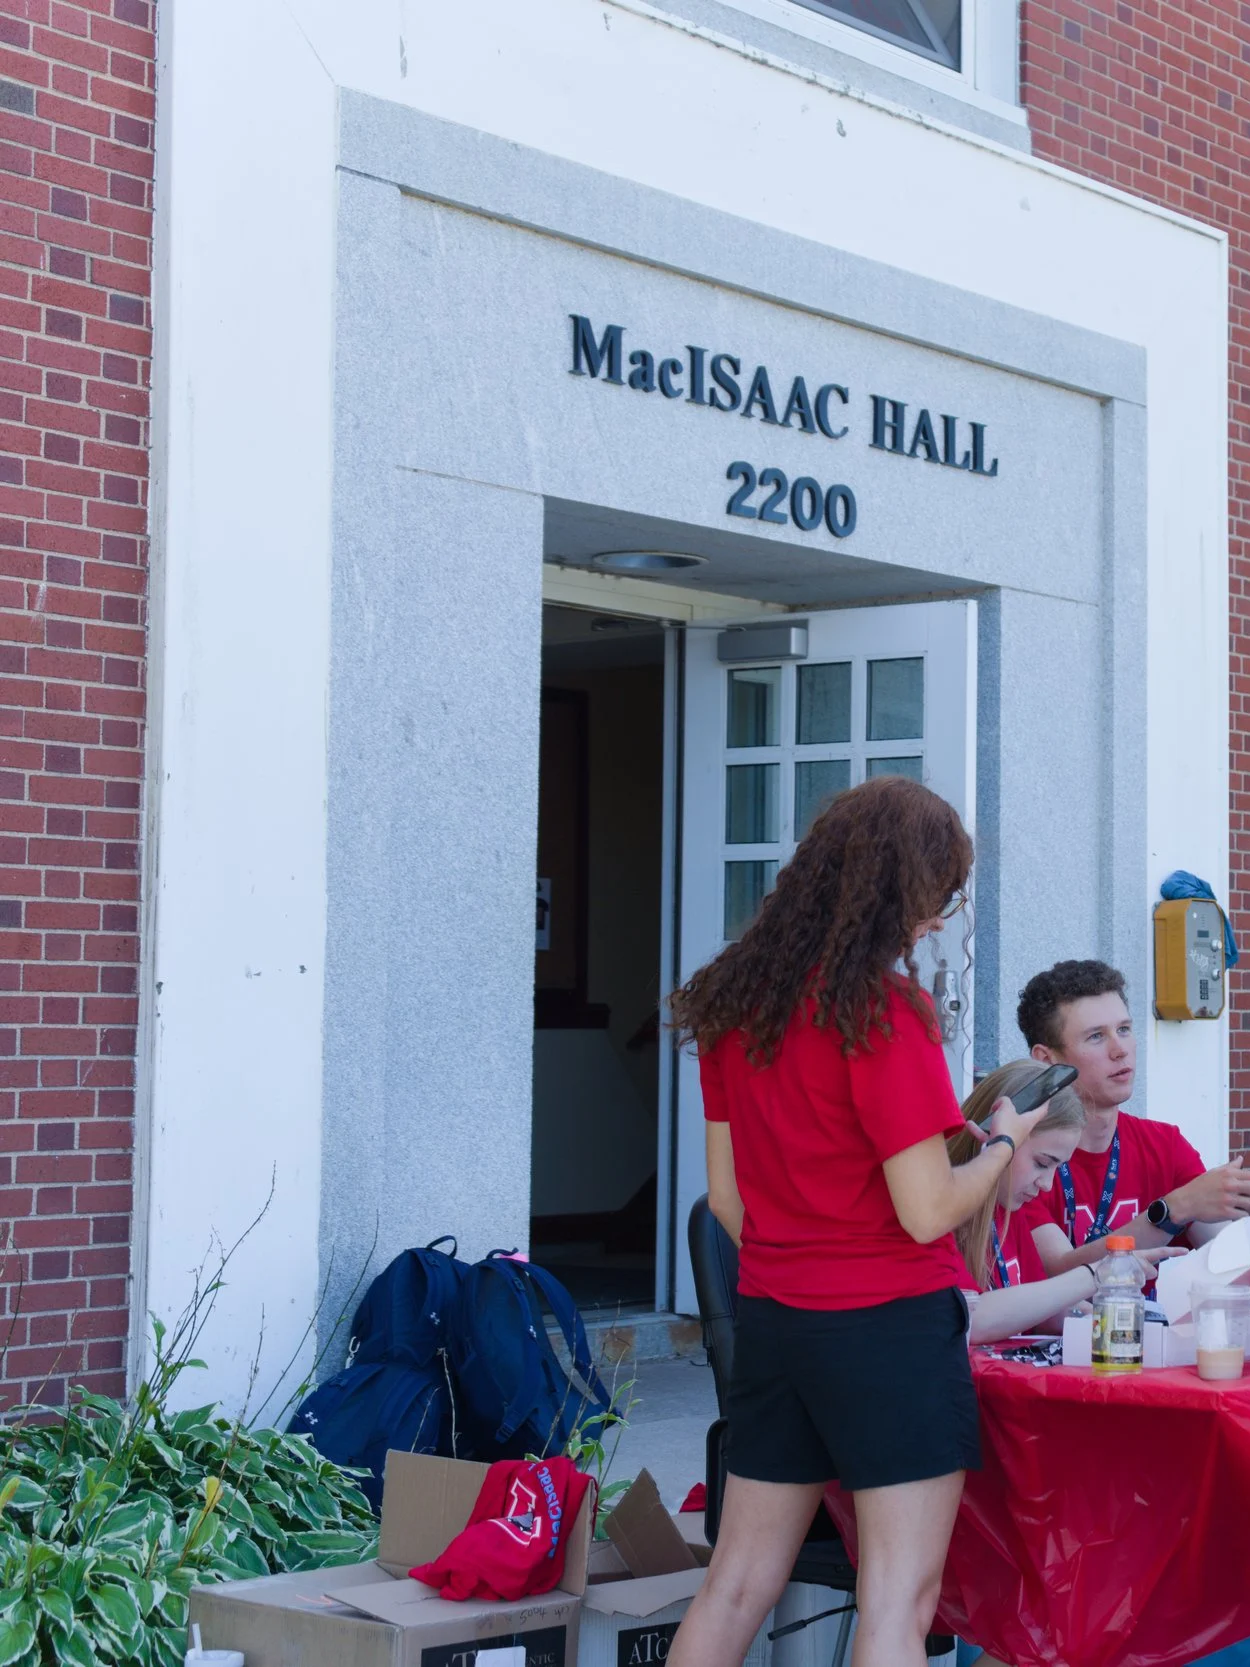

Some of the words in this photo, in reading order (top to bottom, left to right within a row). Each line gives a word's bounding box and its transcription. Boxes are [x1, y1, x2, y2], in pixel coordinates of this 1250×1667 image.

[568, 313, 850, 440] MacISAAC
[868, 393, 999, 478] HALL
[725, 460, 858, 539] 2200
[628, 1632, 669, 1665] ATC
